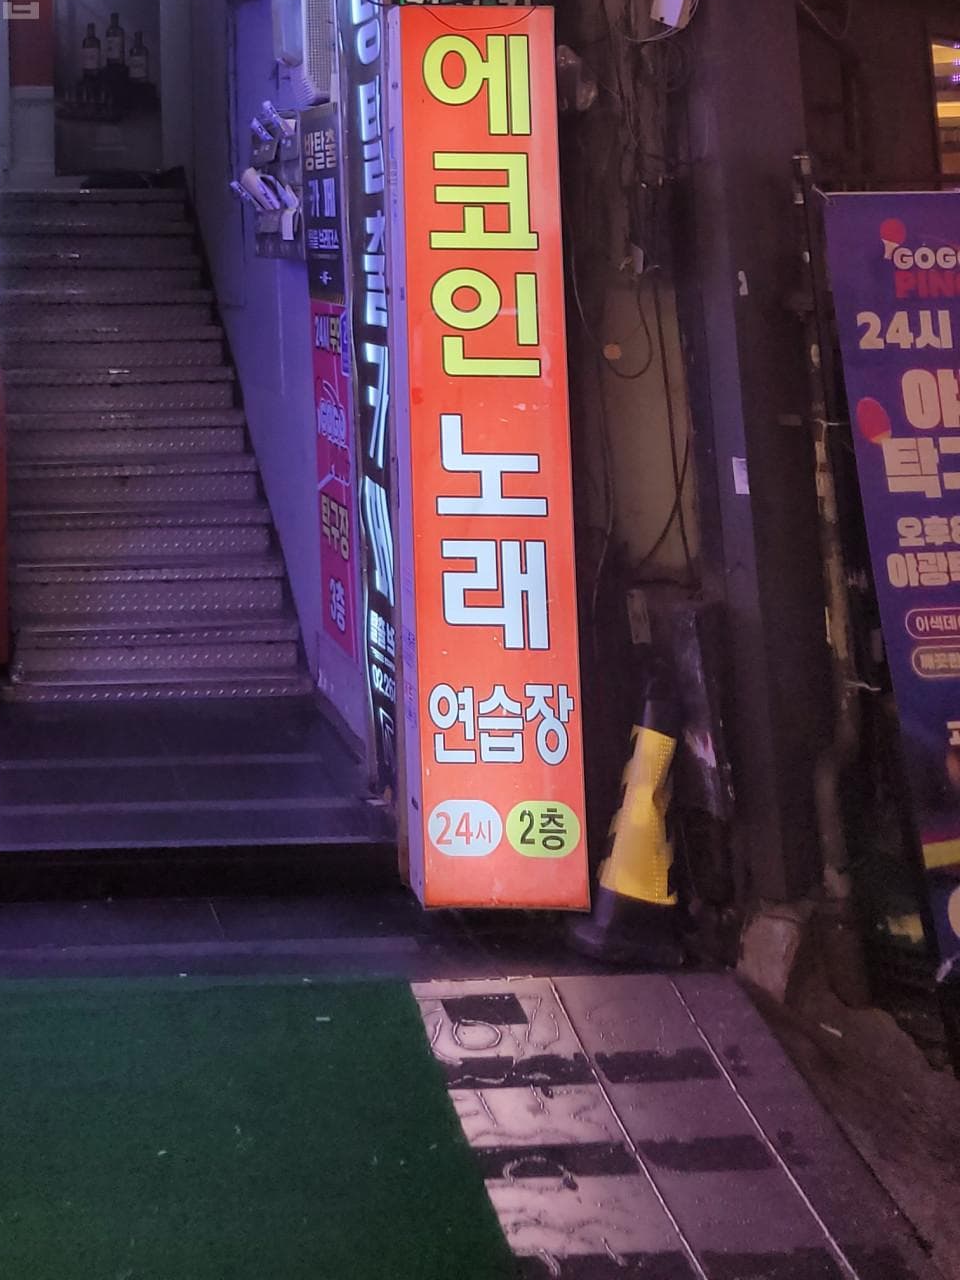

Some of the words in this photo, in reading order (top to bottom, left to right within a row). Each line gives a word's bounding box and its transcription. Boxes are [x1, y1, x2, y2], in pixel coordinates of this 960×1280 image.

[893, 246, 960, 270] GOG
[895, 271, 960, 299] PIN
[856, 310, 953, 349] 24시
[436, 412, 551, 651] 노래
[915, 615, 960, 632] 이색데
[428, 683, 575, 767] 연습장
[436, 810, 493, 847] 24시
[518, 806, 568, 852] 2층
